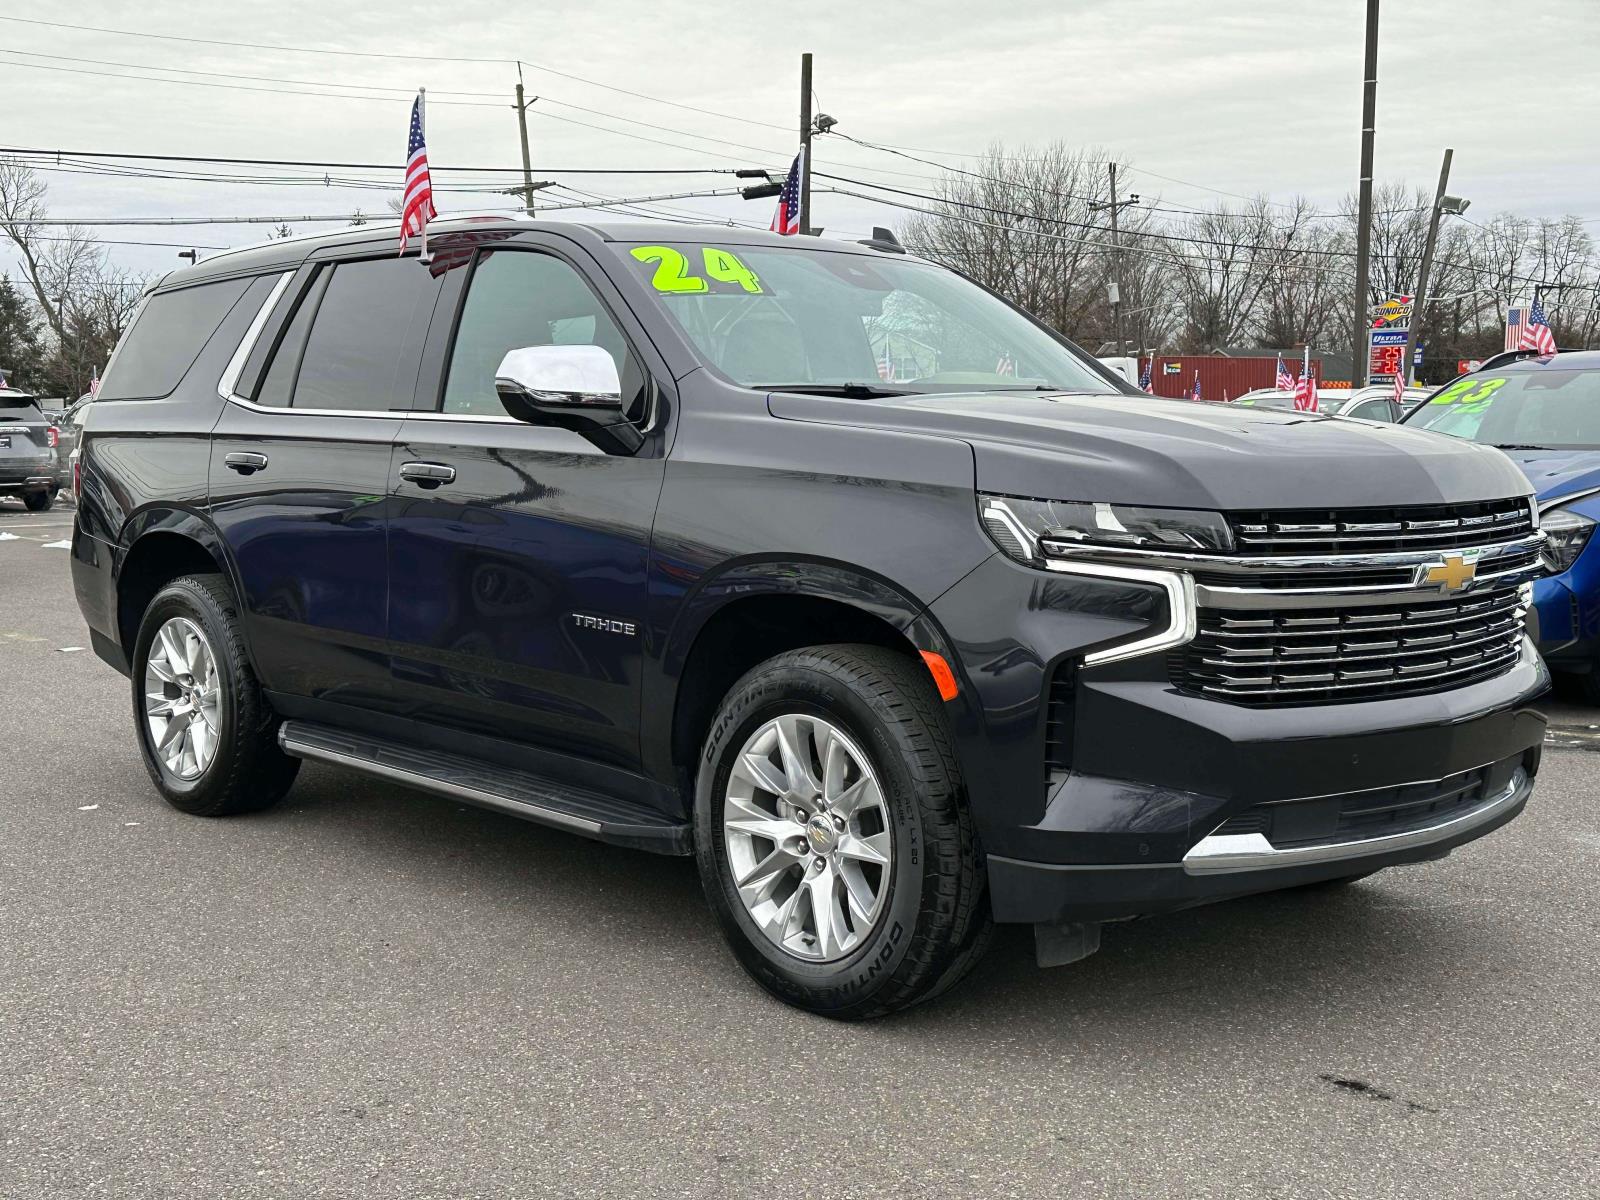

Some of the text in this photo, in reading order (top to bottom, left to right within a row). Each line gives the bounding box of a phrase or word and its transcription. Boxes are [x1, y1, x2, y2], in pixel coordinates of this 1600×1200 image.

[629, 245, 763, 294] 24
[1373, 306, 1410, 316] SUNOCO
[1430, 379, 1506, 404] 23
[572, 613, 635, 636] TAHOE
